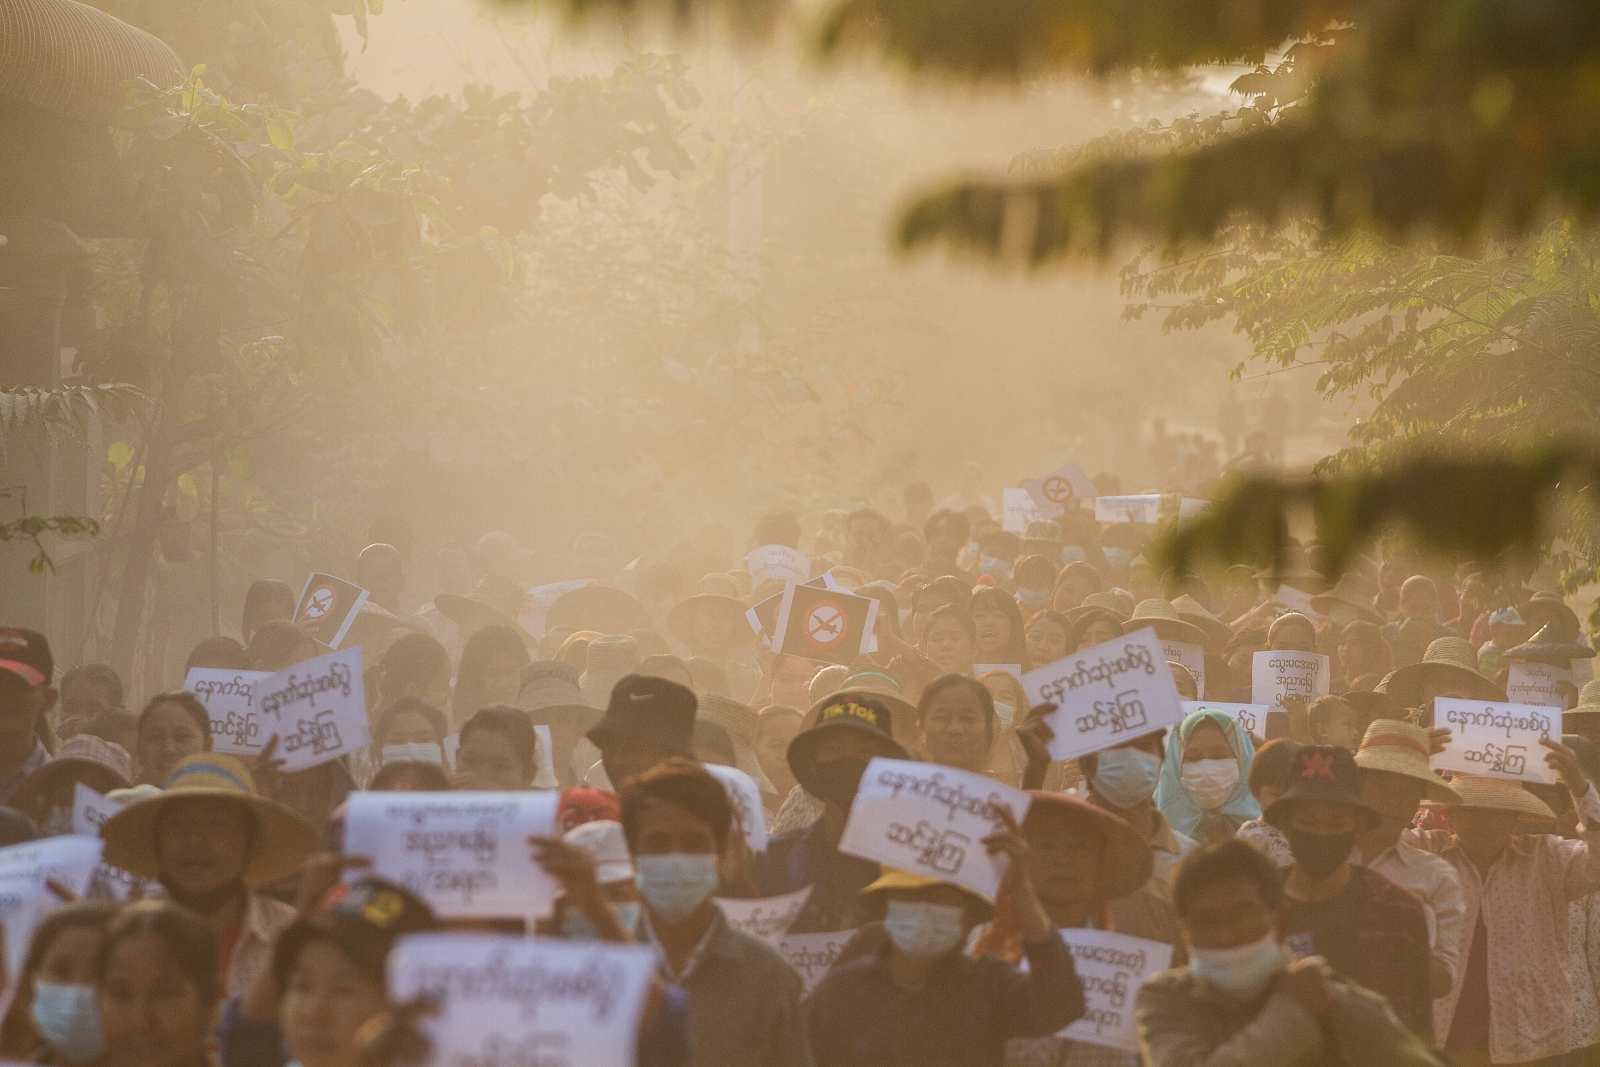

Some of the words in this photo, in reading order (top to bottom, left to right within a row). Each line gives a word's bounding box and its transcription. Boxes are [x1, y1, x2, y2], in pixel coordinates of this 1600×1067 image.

[1038, 643, 1156, 703] နောက်ဆုံးစစ်ပွဲ
[1268, 658, 1320, 675] သွေးမအေးတဲ့
[1276, 672, 1313, 693] အညာမြေ
[1075, 688, 1148, 734] ဆင်နွှဲကြ
[1446, 706, 1551, 741] နောက်ဆုံးစစ်ပွဲ
[1463, 742, 1528, 775] ဆင်နွှဲကြ
